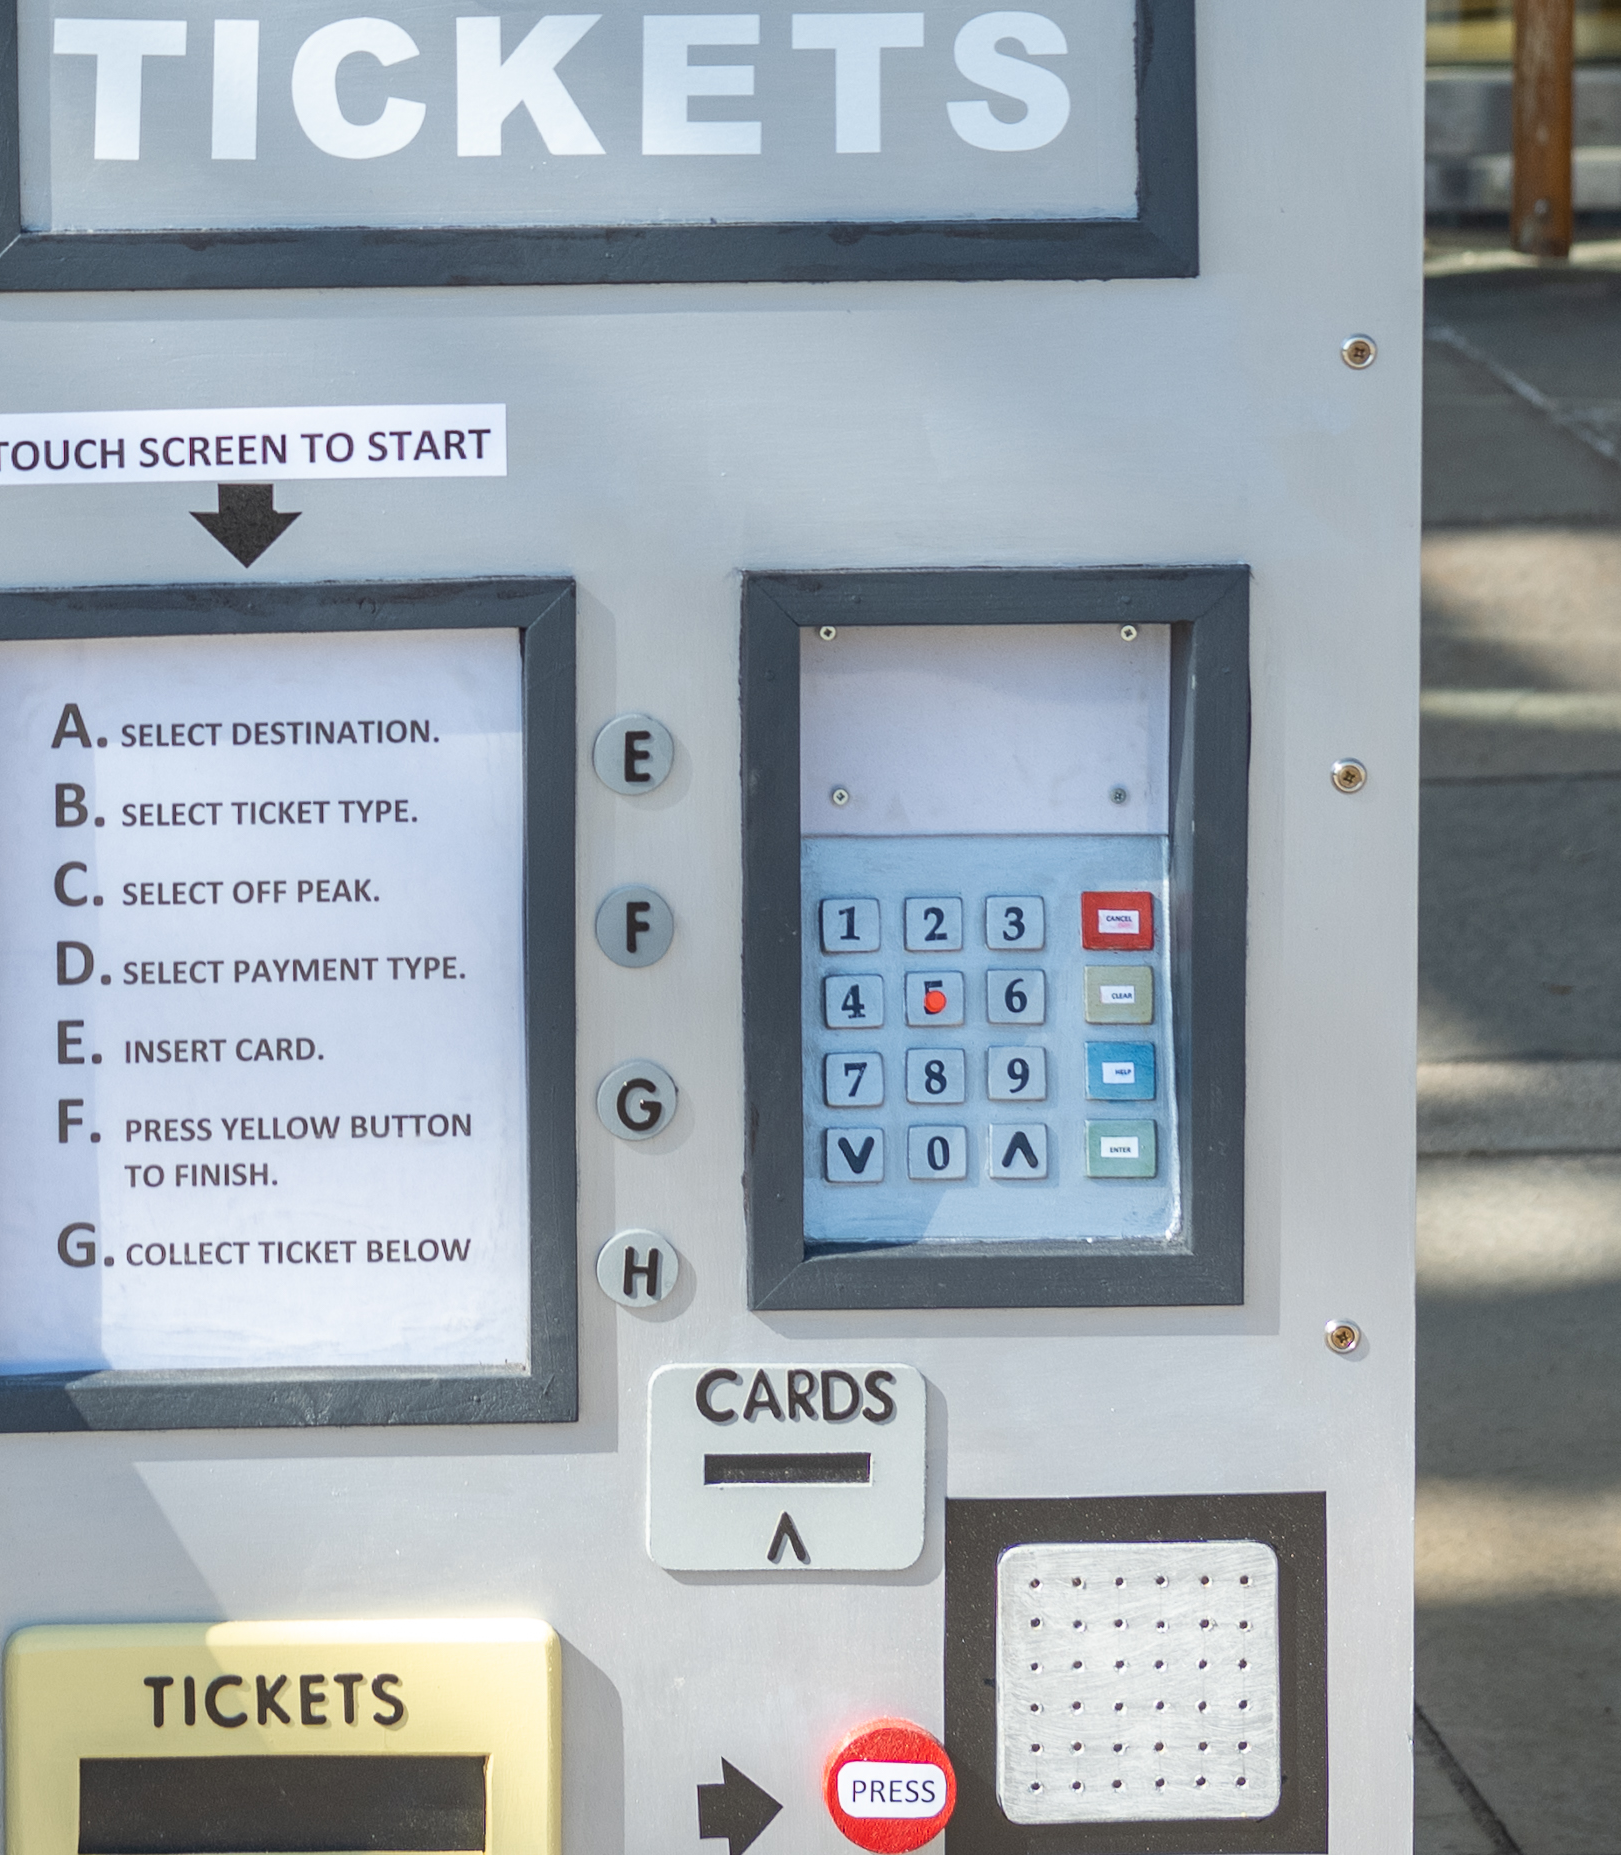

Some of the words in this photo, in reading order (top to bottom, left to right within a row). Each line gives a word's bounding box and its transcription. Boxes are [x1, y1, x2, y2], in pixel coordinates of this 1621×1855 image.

[52, 11, 1071, 161] TICKETS
[139, 434, 287, 468] SCREEN
[300, 432, 354, 464] TO
[367, 428, 492, 462] START
[50, 702, 108, 749] A.
[121, 722, 223, 748] SELECT
[232, 719, 440, 746] DESTINATION.
[624, 730, 652, 783] E
[54, 782, 105, 828] B.
[121, 802, 224, 827] SELECT
[230, 800, 331, 826] TICKET
[337, 799, 418, 824] TYPE.
[53, 860, 104, 908] C.
[122, 881, 224, 906] SELECT
[232, 880, 287, 904] OFF
[297, 878, 380, 903] PEAK.
[626, 901, 651, 954] F
[838, 906, 861, 941] 1
[923, 906, 948, 942] 2
[1002, 906, 1026, 942] 3
[1105, 914, 1134, 923] CANCEL
[56, 940, 112, 986] D.
[123, 960, 225, 986] SELECT
[234, 957, 379, 984] PAYMENT
[386, 956, 466, 980] TYPE.
[841, 984, 866, 1019] 4
[1004, 978, 1028, 1014] 6
[1110, 992, 1133, 1000] CLEAR
[57, 1019, 103, 1065] E.
[125, 1039, 227, 1064] INSERT
[235, 1037, 324, 1062] CARD.
[843, 1061, 868, 1098] 7
[924, 1059, 947, 1095] 8
[1007, 1057, 1030, 1094] 9
[1114, 1068, 1133, 1076] HELP
[58, 1098, 101, 1144] F.
[125, 1117, 213, 1143] PRESS
[220, 1115, 341, 1141] YELLOW
[350, 1113, 472, 1139] BUTTON
[616, 1077, 663, 1132] G
[926, 1135, 950, 1171] 0
[1108, 1146, 1133, 1154] ENTER
[124, 1164, 165, 1188] TO
[175, 1162, 278, 1188] FINISH.
[57, 1221, 115, 1269] G.
[126, 1241, 251, 1267] COLLECT
[257, 1240, 358, 1265] TICKET
[366, 1238, 472, 1263] BELOW
[623, 1246, 660, 1298] H
[695, 1368, 896, 1425] CARDS
[143, 1673, 405, 1729] TICKETS
[852, 1779, 936, 1803] PRESS
